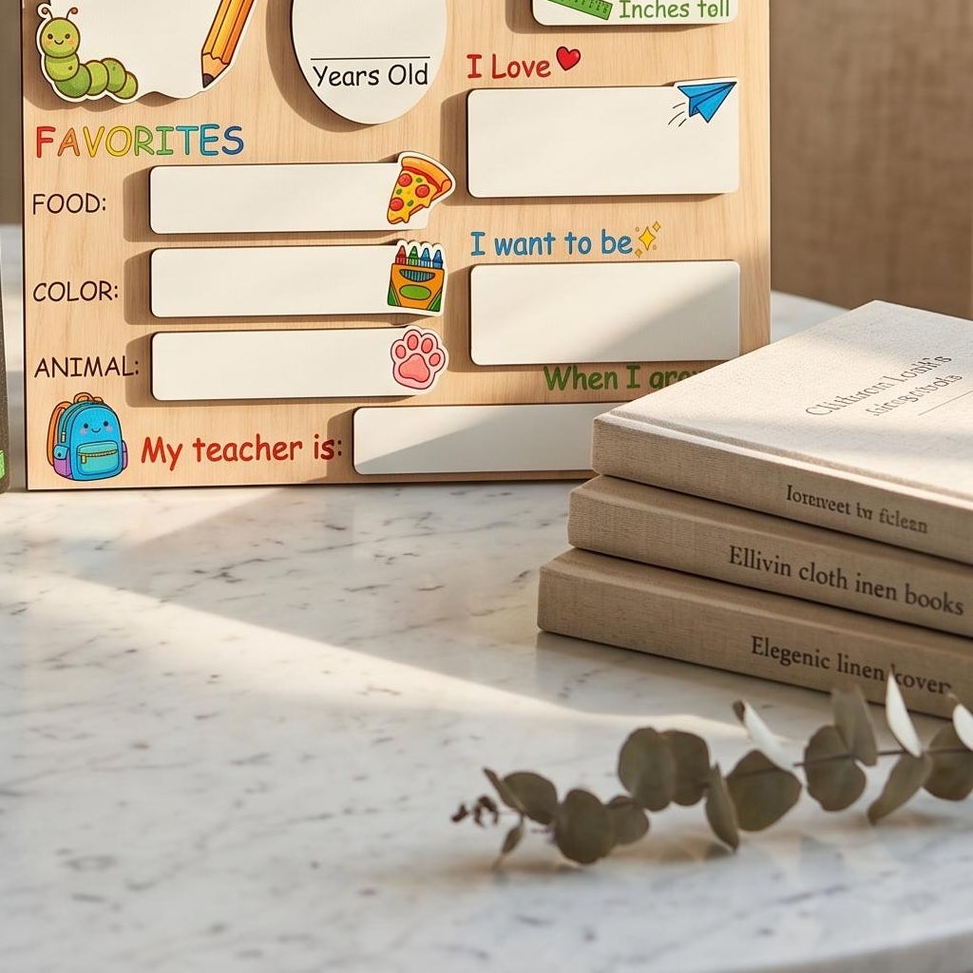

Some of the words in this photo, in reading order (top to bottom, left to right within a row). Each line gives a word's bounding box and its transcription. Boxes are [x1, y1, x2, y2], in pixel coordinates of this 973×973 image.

[313, 64, 380, 88] Years
[388, 62, 429, 86] Old
[467, 54, 482, 79] I
[491, 54, 551, 79] Love
[35, 124, 244, 158] FAVORITES
[31, 193, 107, 215] FOOD:
[471, 232, 486, 256] I
[495, 232, 557, 256] want
[564, 230, 591, 255] to
[601, 229, 633, 255] be
[32, 281, 119, 303] COLOR:
[33, 355, 139, 378] ANIMAL:
[543, 364, 618, 391] When
[626, 365, 641, 389] I
[141, 437, 182, 472] My
[192, 434, 303, 462] teacher
[313, 435, 343, 462] is:
[729, 545, 792, 578] Ellivin
[799, 563, 848, 590] cloth
[855, 573, 897, 601] inen
[905, 583, 964, 616] books
[751, 635, 830, 668] Elegenic
[836, 653, 885, 681] linen
